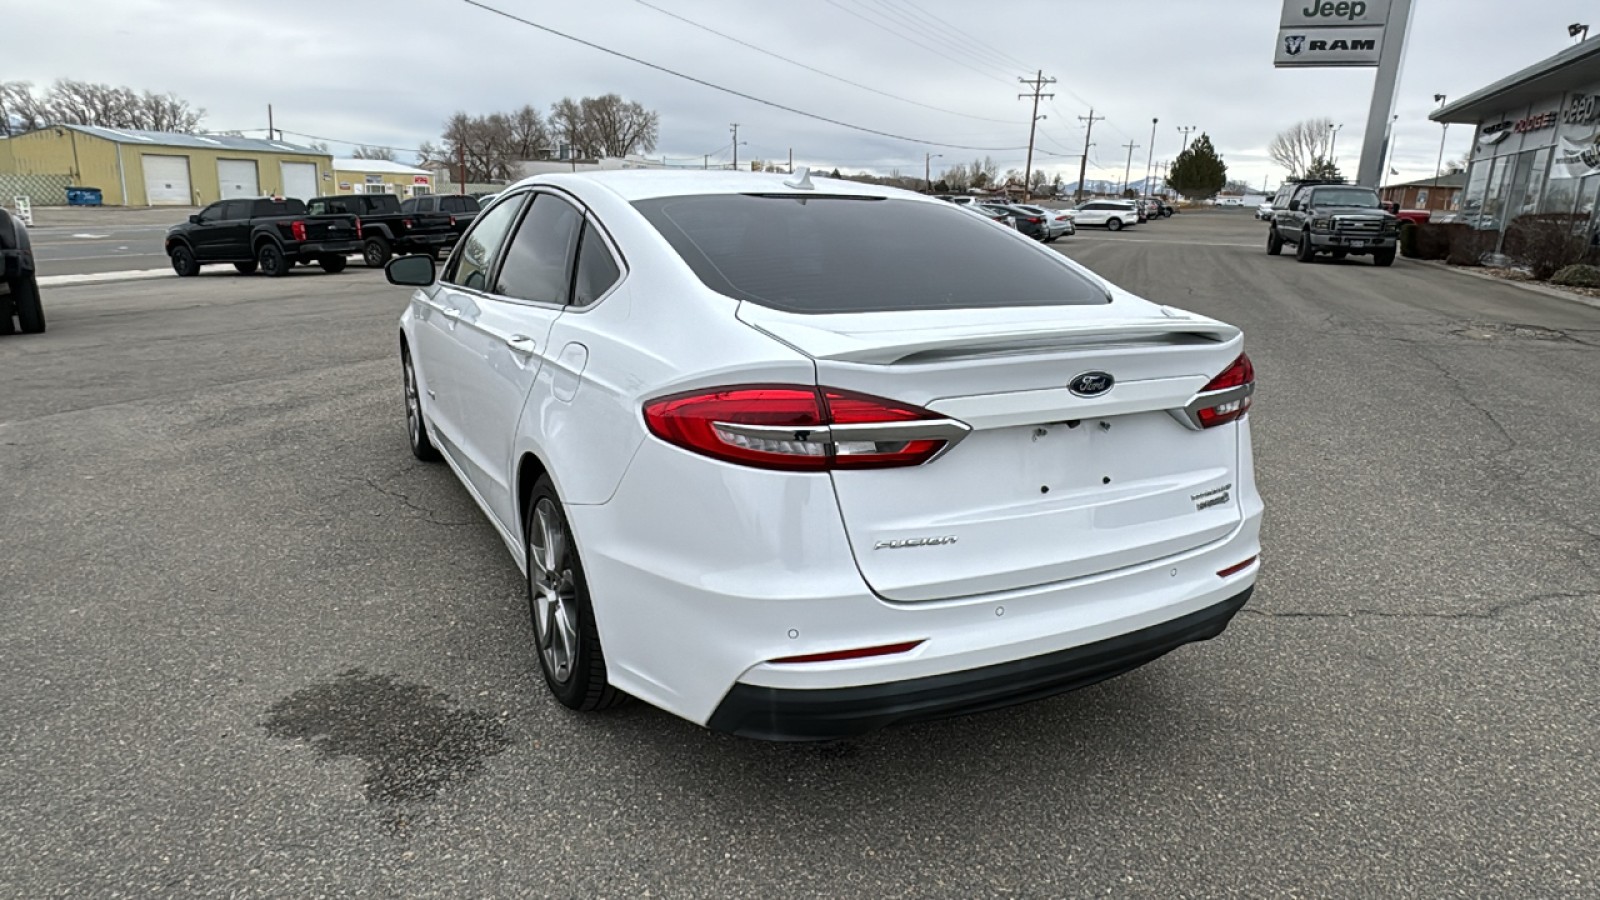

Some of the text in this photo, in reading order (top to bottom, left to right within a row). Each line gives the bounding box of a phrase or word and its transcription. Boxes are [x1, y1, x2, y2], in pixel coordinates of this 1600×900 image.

[1303, 0, 1366, 20] Jeep
[1309, 40, 1376, 50] RAM
[1514, 111, 1557, 134] DODGE
[1080, 375, 1106, 391] Ford
[874, 535, 959, 550] FUSION
